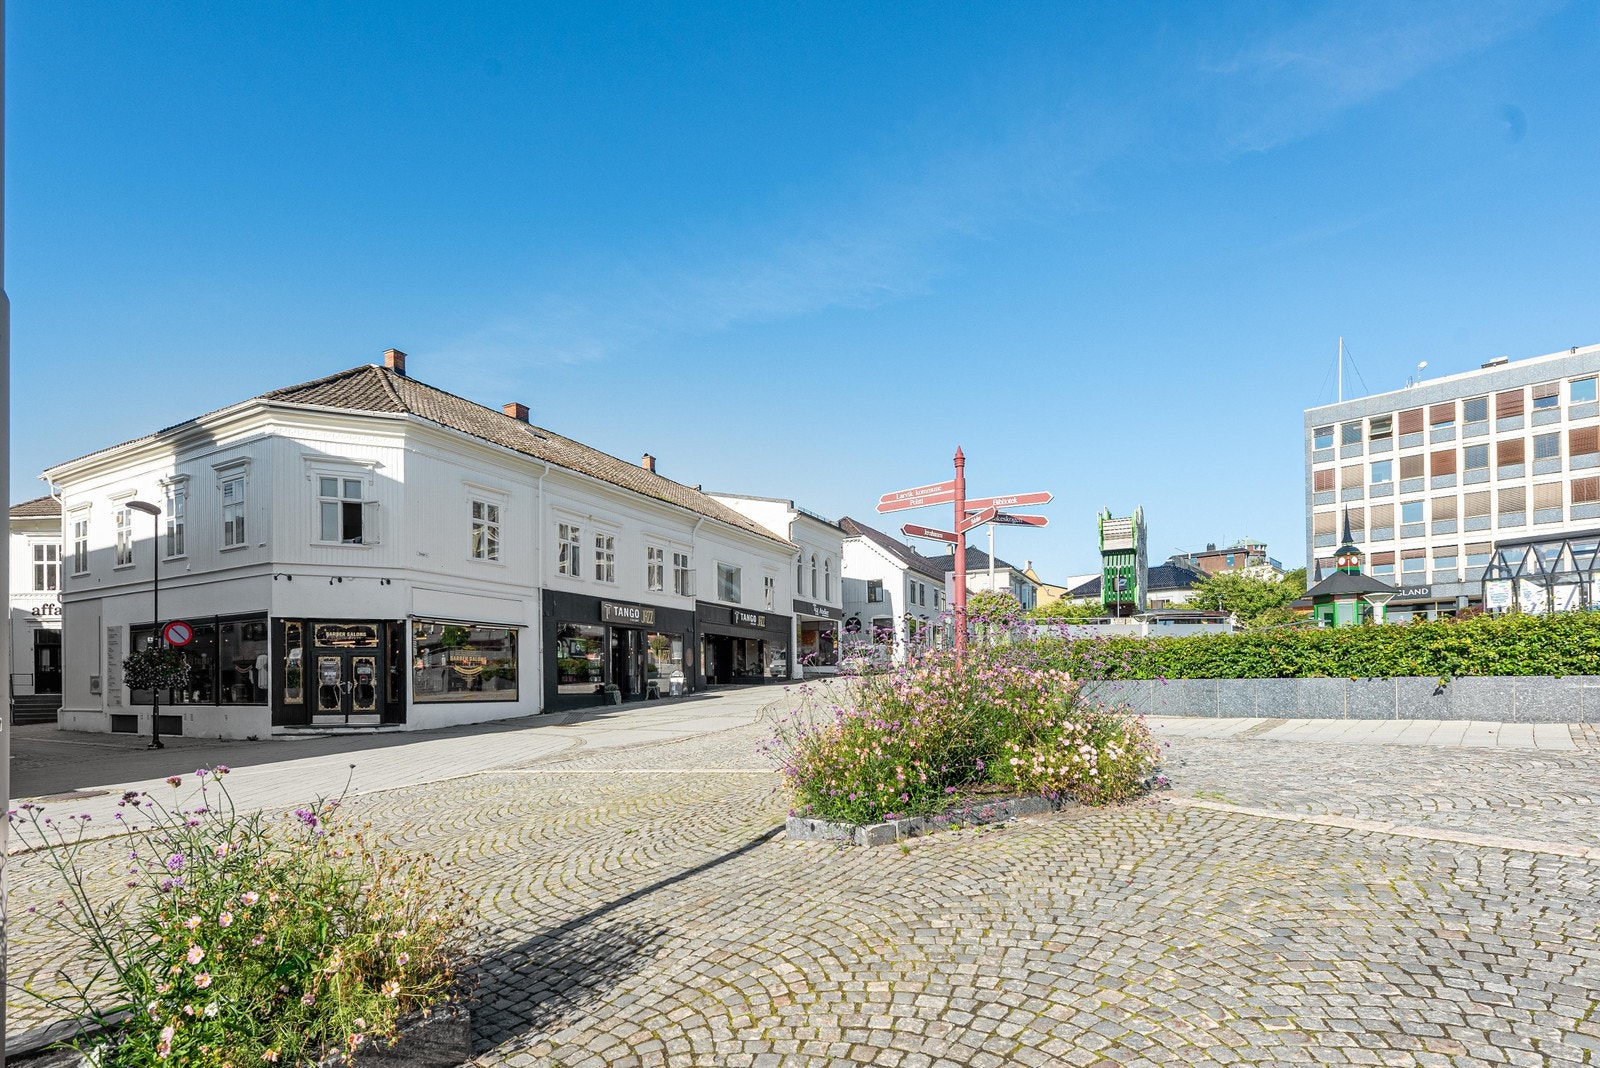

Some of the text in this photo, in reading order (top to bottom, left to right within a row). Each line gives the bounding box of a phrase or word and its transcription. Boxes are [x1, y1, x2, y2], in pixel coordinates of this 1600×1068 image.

[896, 486, 942, 500] Larvik kommune
[909, 498, 924, 506] Politi
[613, 606, 640, 619] TANGO
[740, 612, 757, 623] TANGO
